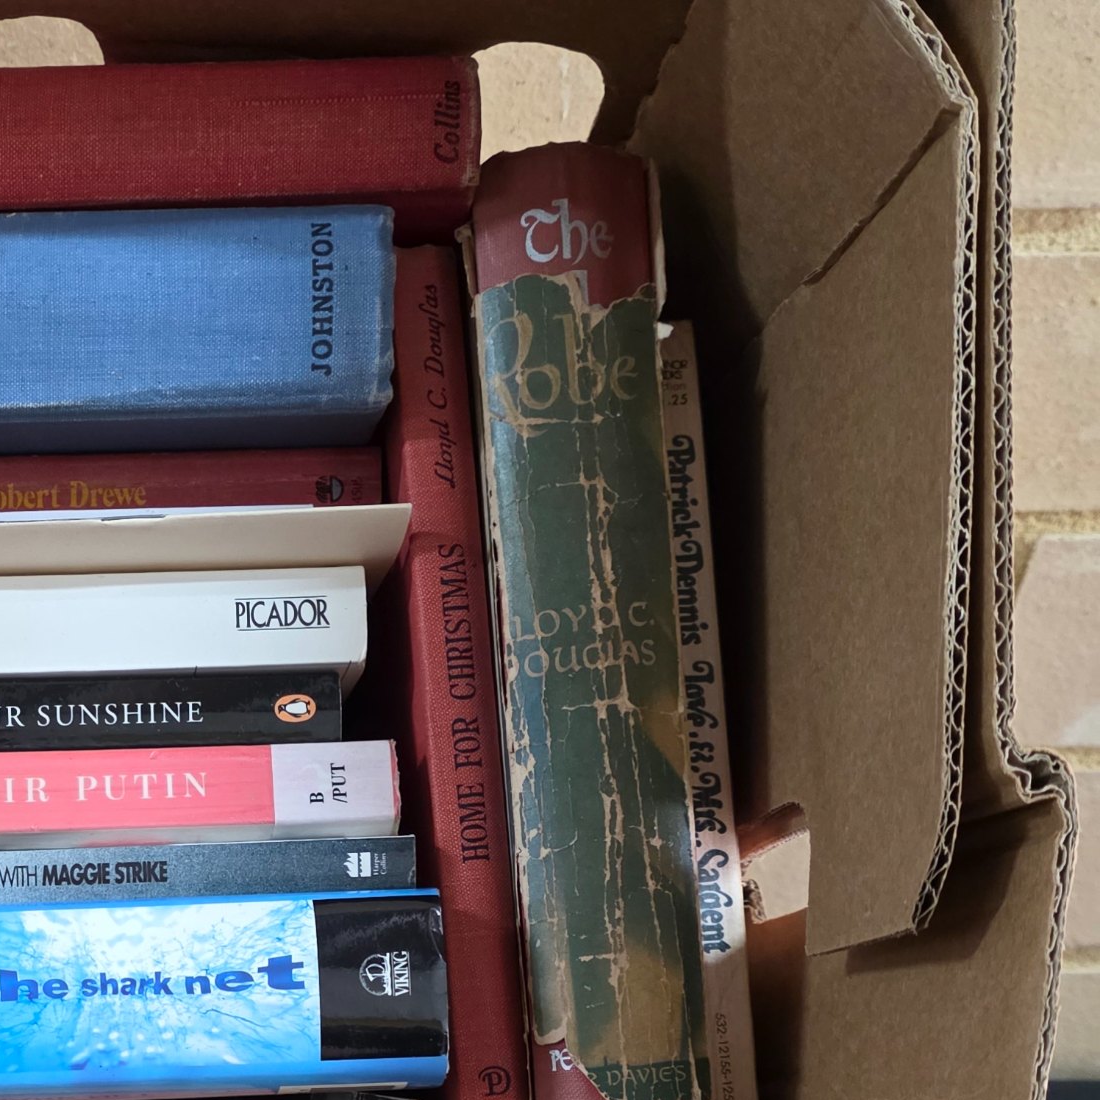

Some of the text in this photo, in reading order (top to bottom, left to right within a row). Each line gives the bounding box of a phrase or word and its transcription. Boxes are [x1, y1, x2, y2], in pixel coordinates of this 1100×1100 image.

[434, 80, 461, 165] Collins
[519, 198, 615, 265] The
[311, 222, 332, 377] JOHNSTON
[419, 283, 456, 490] Lloyd Douglas
[486, 312, 638, 438] Robe
[69, 480, 148, 508] Drewe
[667, 435, 701, 539] Patrick
[235, 598, 330, 629] PICADOR
[675, 540, 708, 646] Dennis
[37, 701, 205, 728] SUNSHINE
[437, 543, 490, 864] HOME FOR CHRISTMAS
[76, 771, 209, 801] PUTIN
[309, 791, 325, 805] B
[331, 762, 346, 804] /PUT
[42, 863, 109, 886] MAGGIE
[114, 861, 168, 884] STRIKE
[697, 849, 733, 954] Sargent
[81, 972, 174, 997] shark
[185, 955, 305, 996] net
[393, 951, 410, 996] VIKING
[606, 1065, 687, 1086] DAVIES
